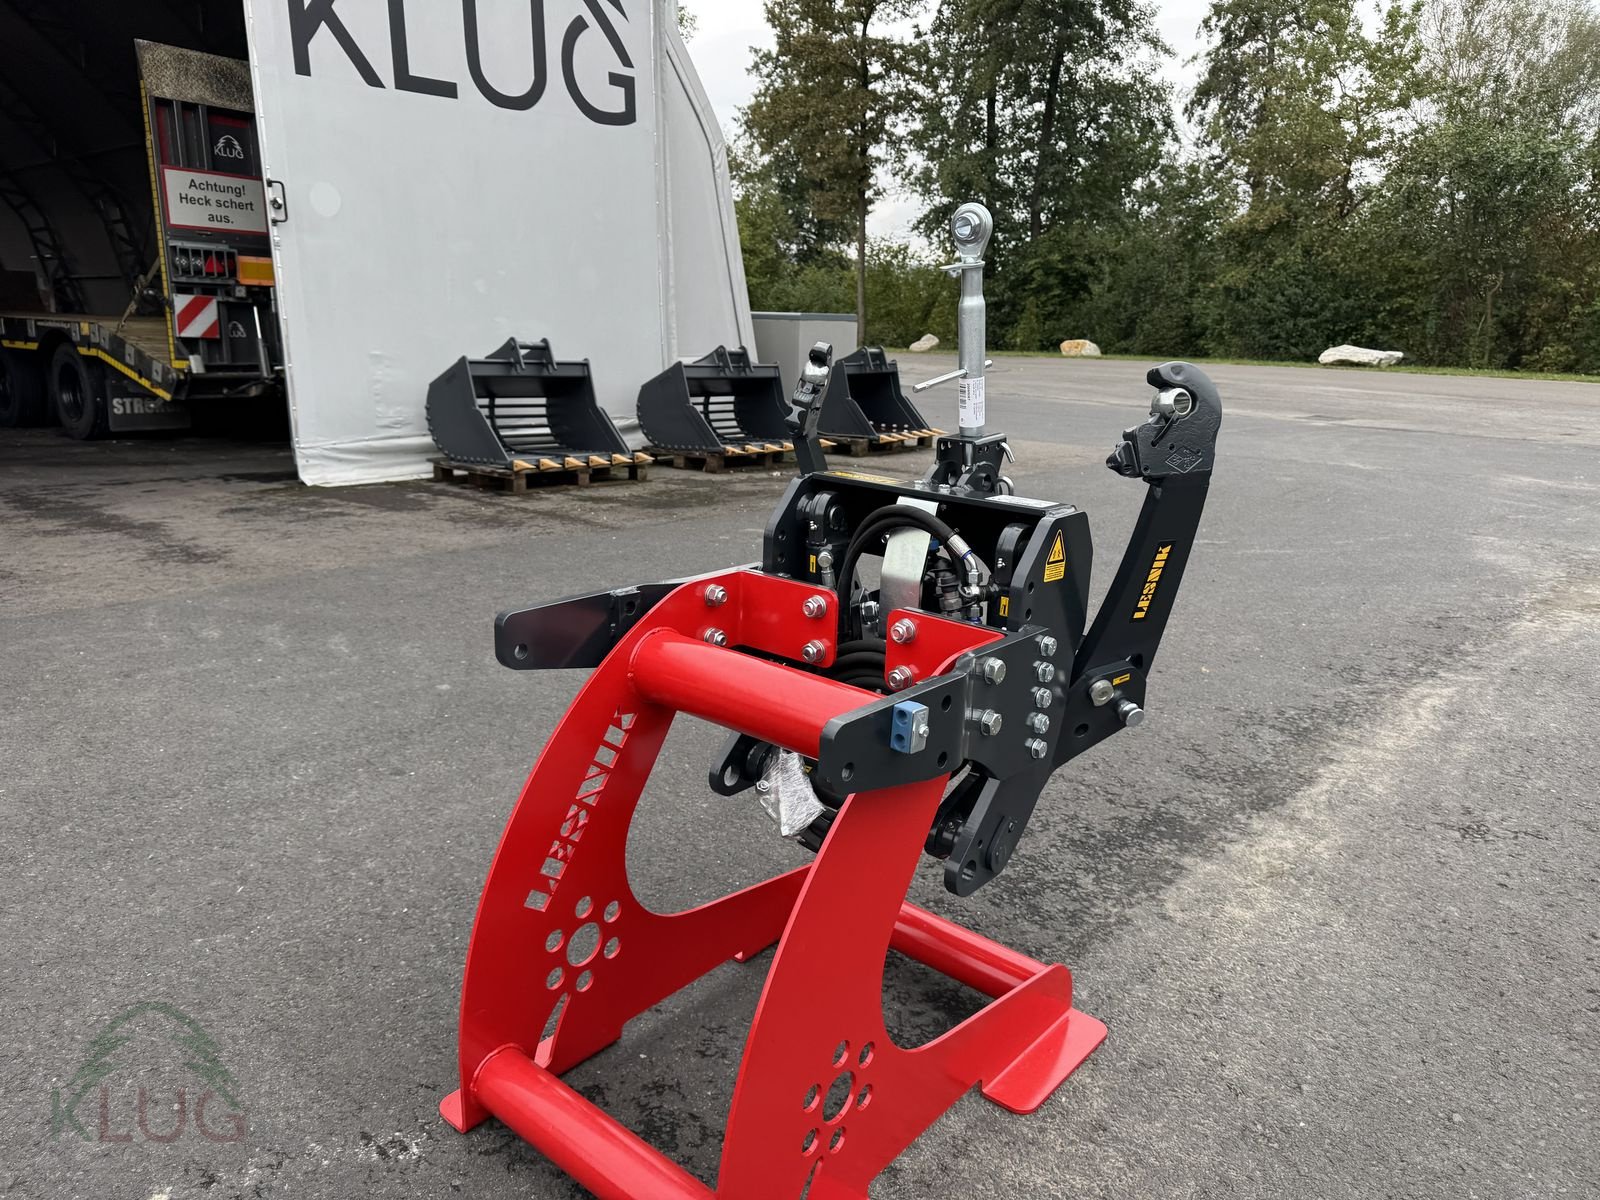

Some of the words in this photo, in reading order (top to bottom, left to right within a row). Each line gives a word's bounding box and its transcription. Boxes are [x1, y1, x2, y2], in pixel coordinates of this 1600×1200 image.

[288, 0, 637, 126] KLUG
[214, 146, 244, 159] KLUG
[188, 179, 246, 197] Achtung!
[179, 193, 212, 207] Heck
[215, 198, 255, 212] schert
[207, 212, 234, 225] aus.
[1133, 544, 1172, 619] LESNIK
[523, 705, 638, 912] LESNIK
